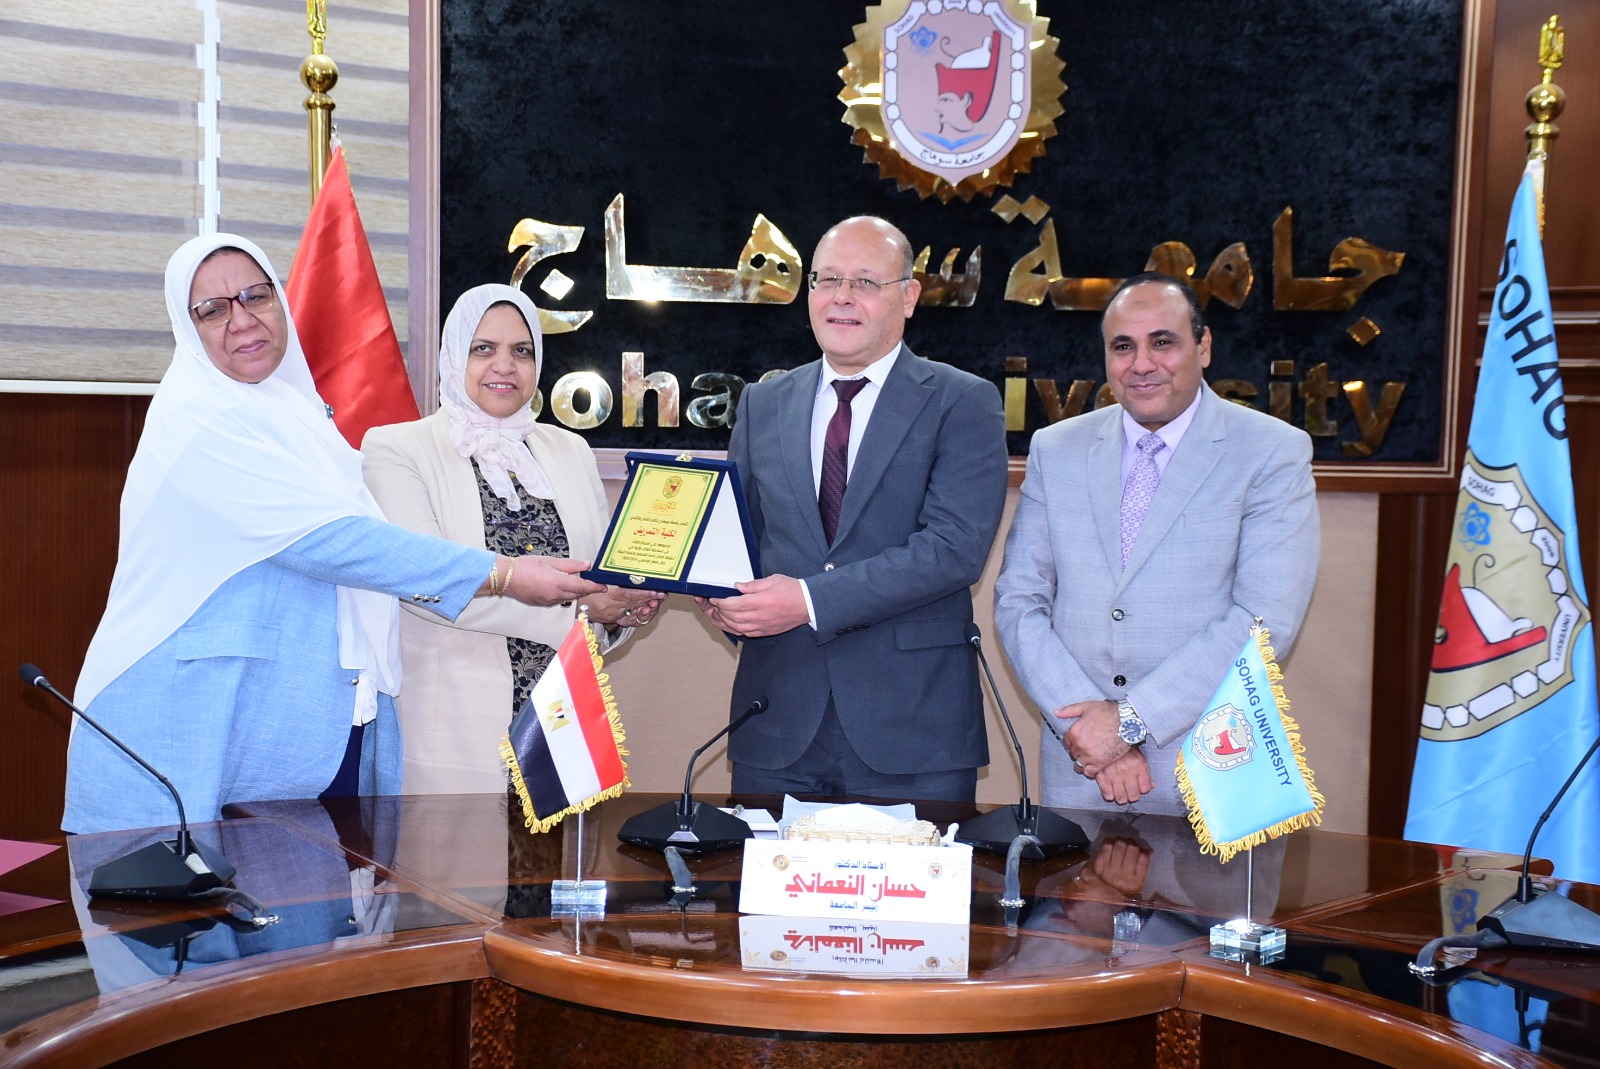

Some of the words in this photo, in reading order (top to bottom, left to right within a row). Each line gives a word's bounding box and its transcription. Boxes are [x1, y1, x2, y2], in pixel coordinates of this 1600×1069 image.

[508, 192, 982, 335] سهاج
[531, 351, 790, 429] oha
[1467, 476, 1496, 498] SOHAG
[1553, 613, 1574, 664] UNIVERSITY
[1235, 657, 1261, 707] SOHAG
[1253, 708, 1293, 787] UNIVERSITY
[834, 858, 861, 870] الدكتور
[784, 871, 866, 898] النعماني
[868, 875, 927, 902] حسان
[829, 900, 858, 912] الجامعة
